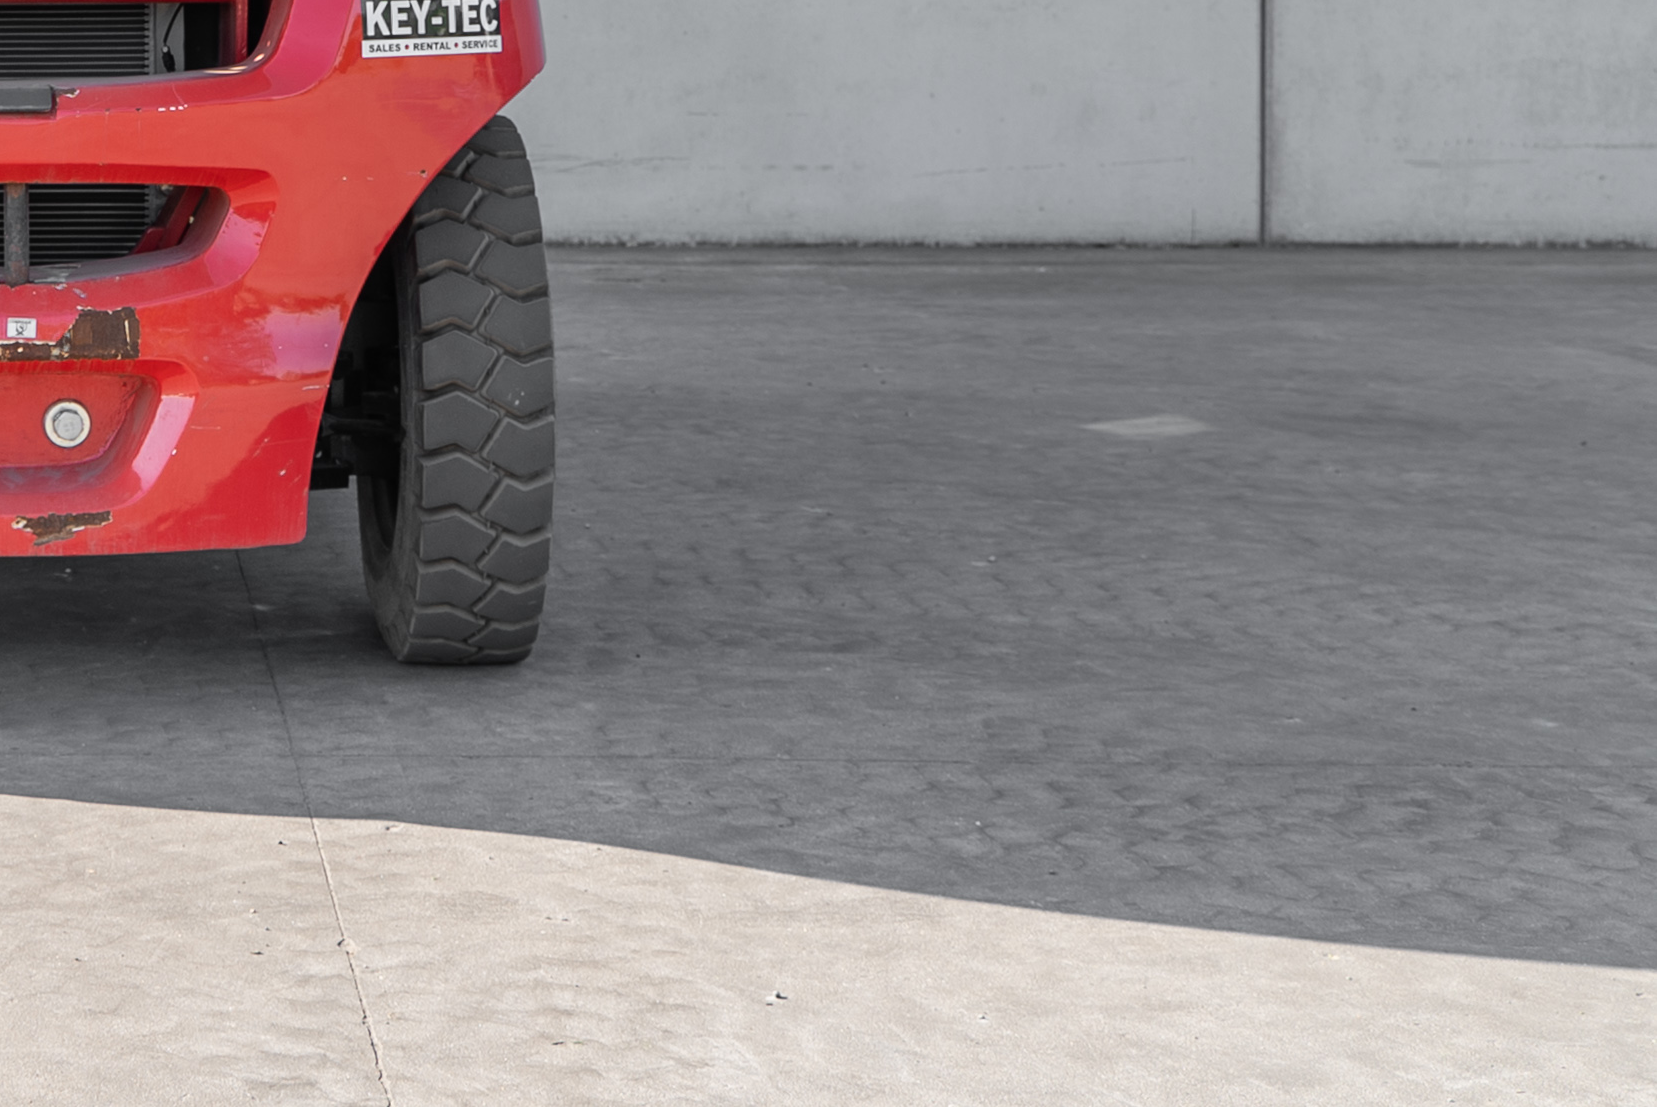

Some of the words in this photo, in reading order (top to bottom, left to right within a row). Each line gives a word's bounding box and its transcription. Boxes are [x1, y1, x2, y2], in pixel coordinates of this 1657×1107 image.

[368, 44, 401, 53] SALES
[413, 42, 451, 51] RENTAL
[461, 39, 498, 49] SERVICE
